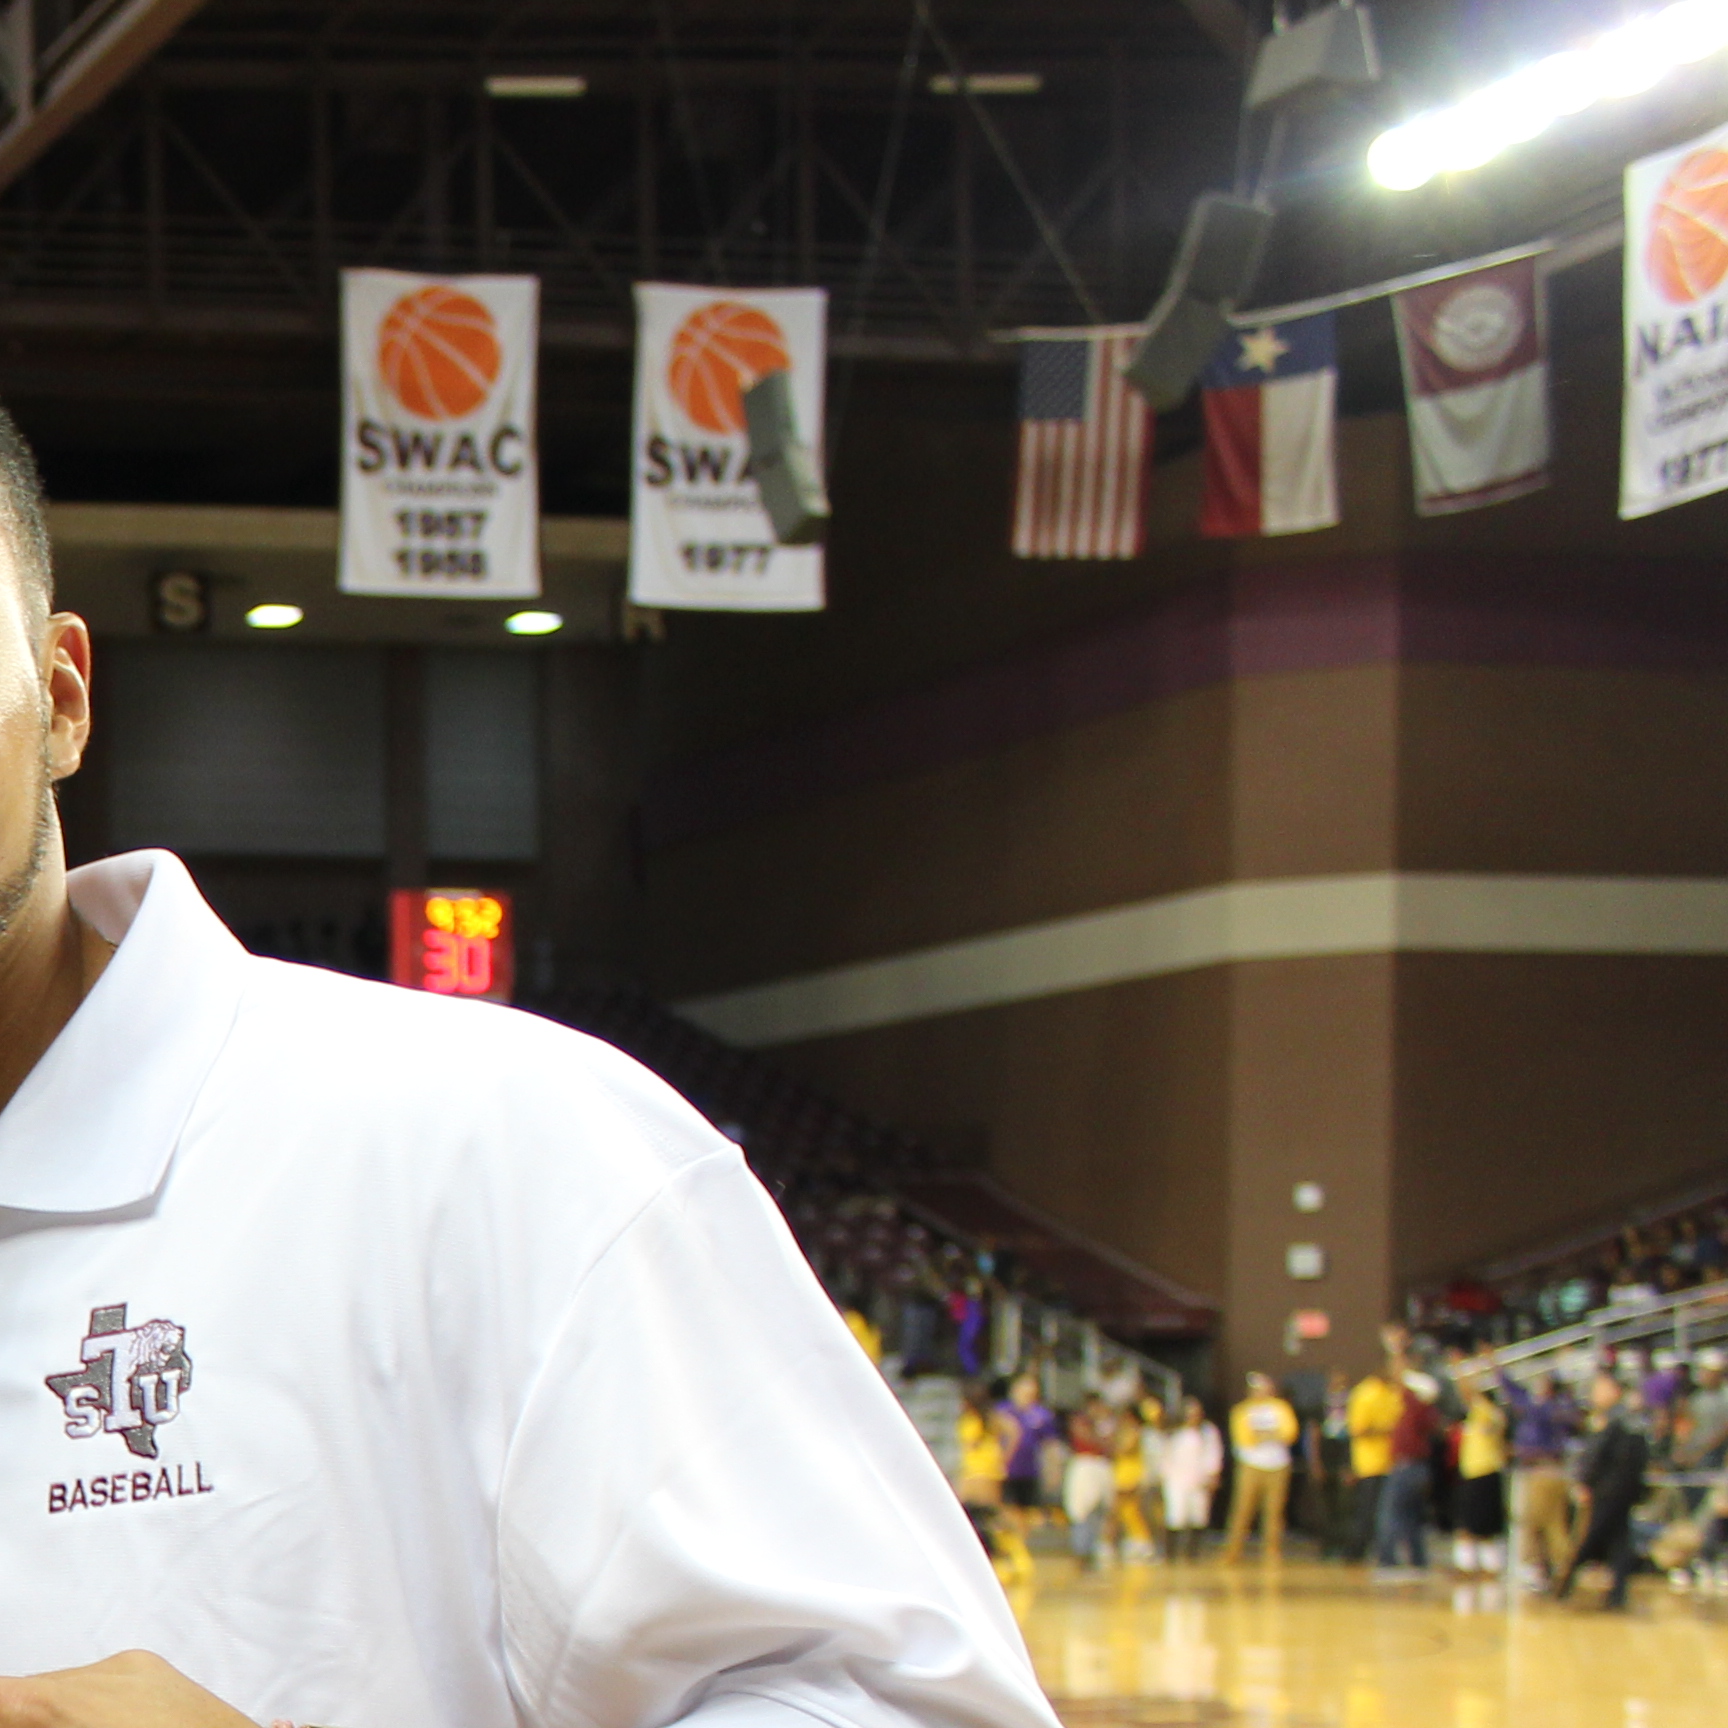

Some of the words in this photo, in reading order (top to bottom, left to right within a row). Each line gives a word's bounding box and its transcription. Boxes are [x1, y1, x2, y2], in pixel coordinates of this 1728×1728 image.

[1633, 304, 1728, 378] NAI
[357, 418, 524, 477] SWAC
[159, 572, 206, 625] S
[48, 1461, 215, 1514] BASEBALL
